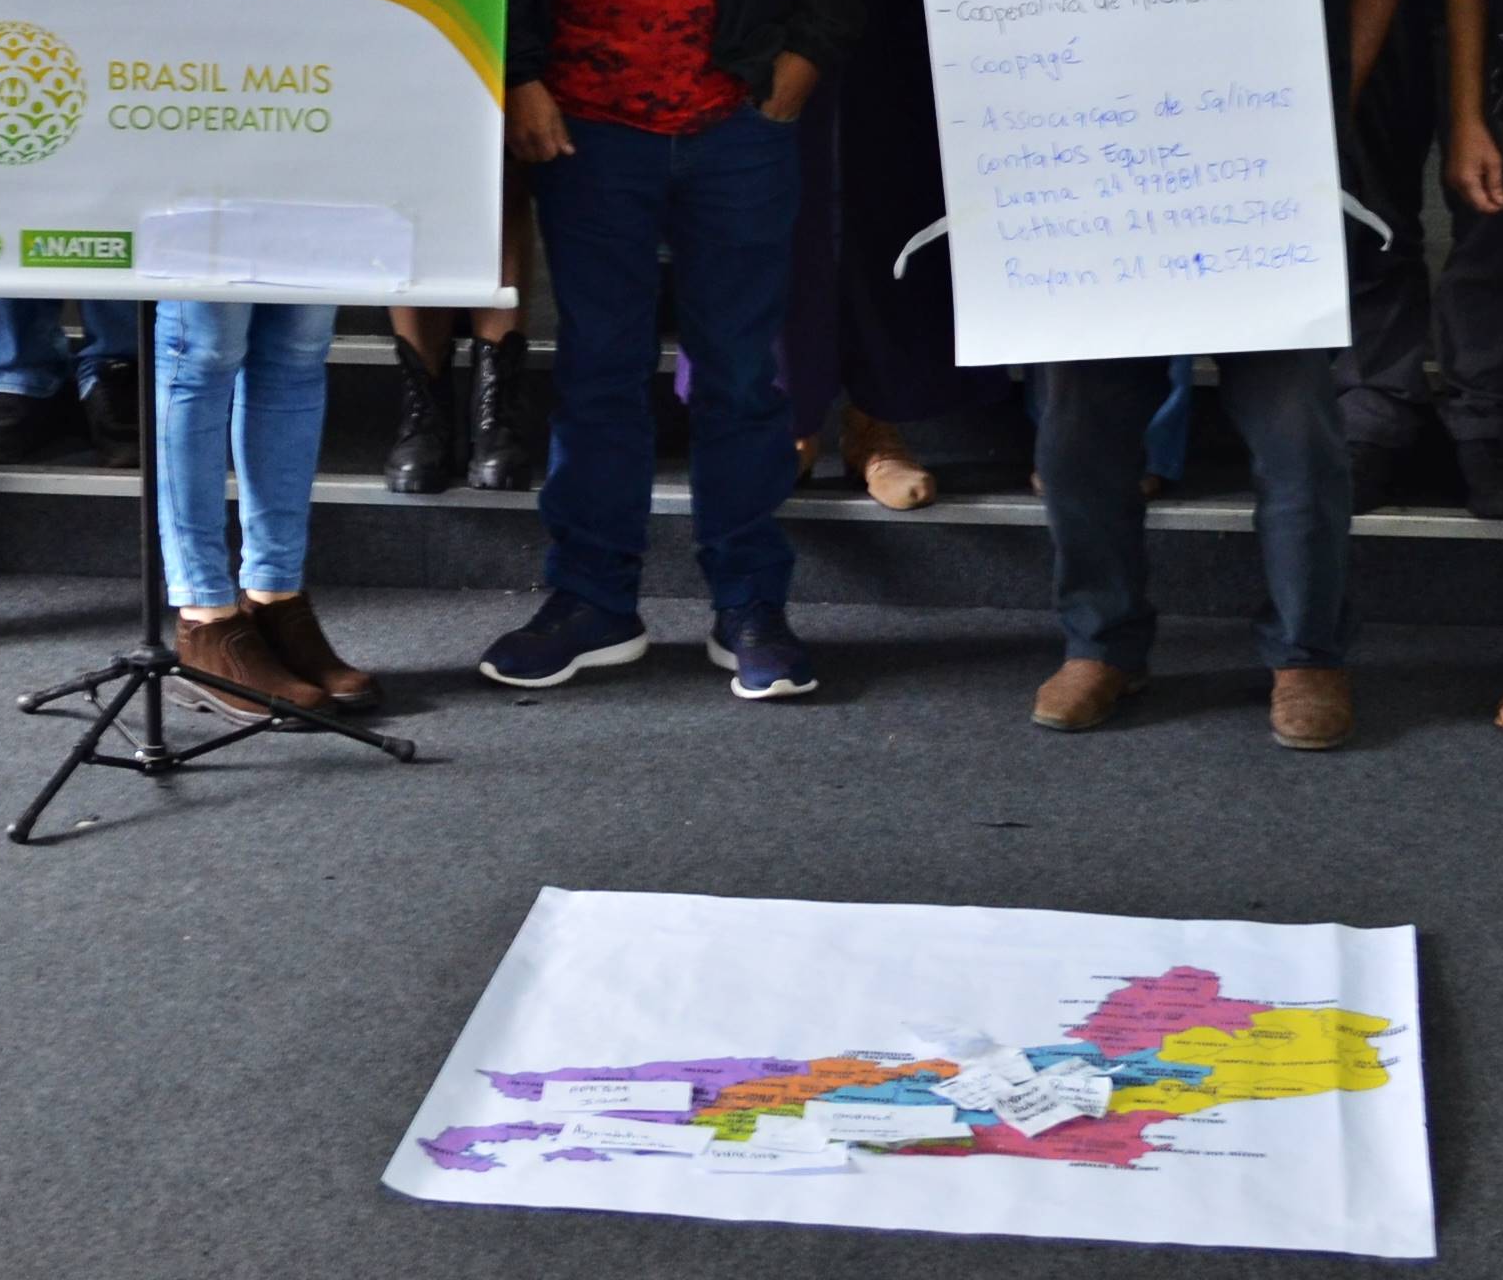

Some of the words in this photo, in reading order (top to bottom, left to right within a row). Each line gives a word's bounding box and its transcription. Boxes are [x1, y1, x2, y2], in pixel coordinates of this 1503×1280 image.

[108, 61, 227, 92] BRASIL
[241, 64, 333, 94] MAIS
[1154, 91, 1185, 118] de
[108, 105, 332, 133] COOPERATIVO
[994, 187, 1080, 208] Luana
[28, 235, 128, 258] ANATER
